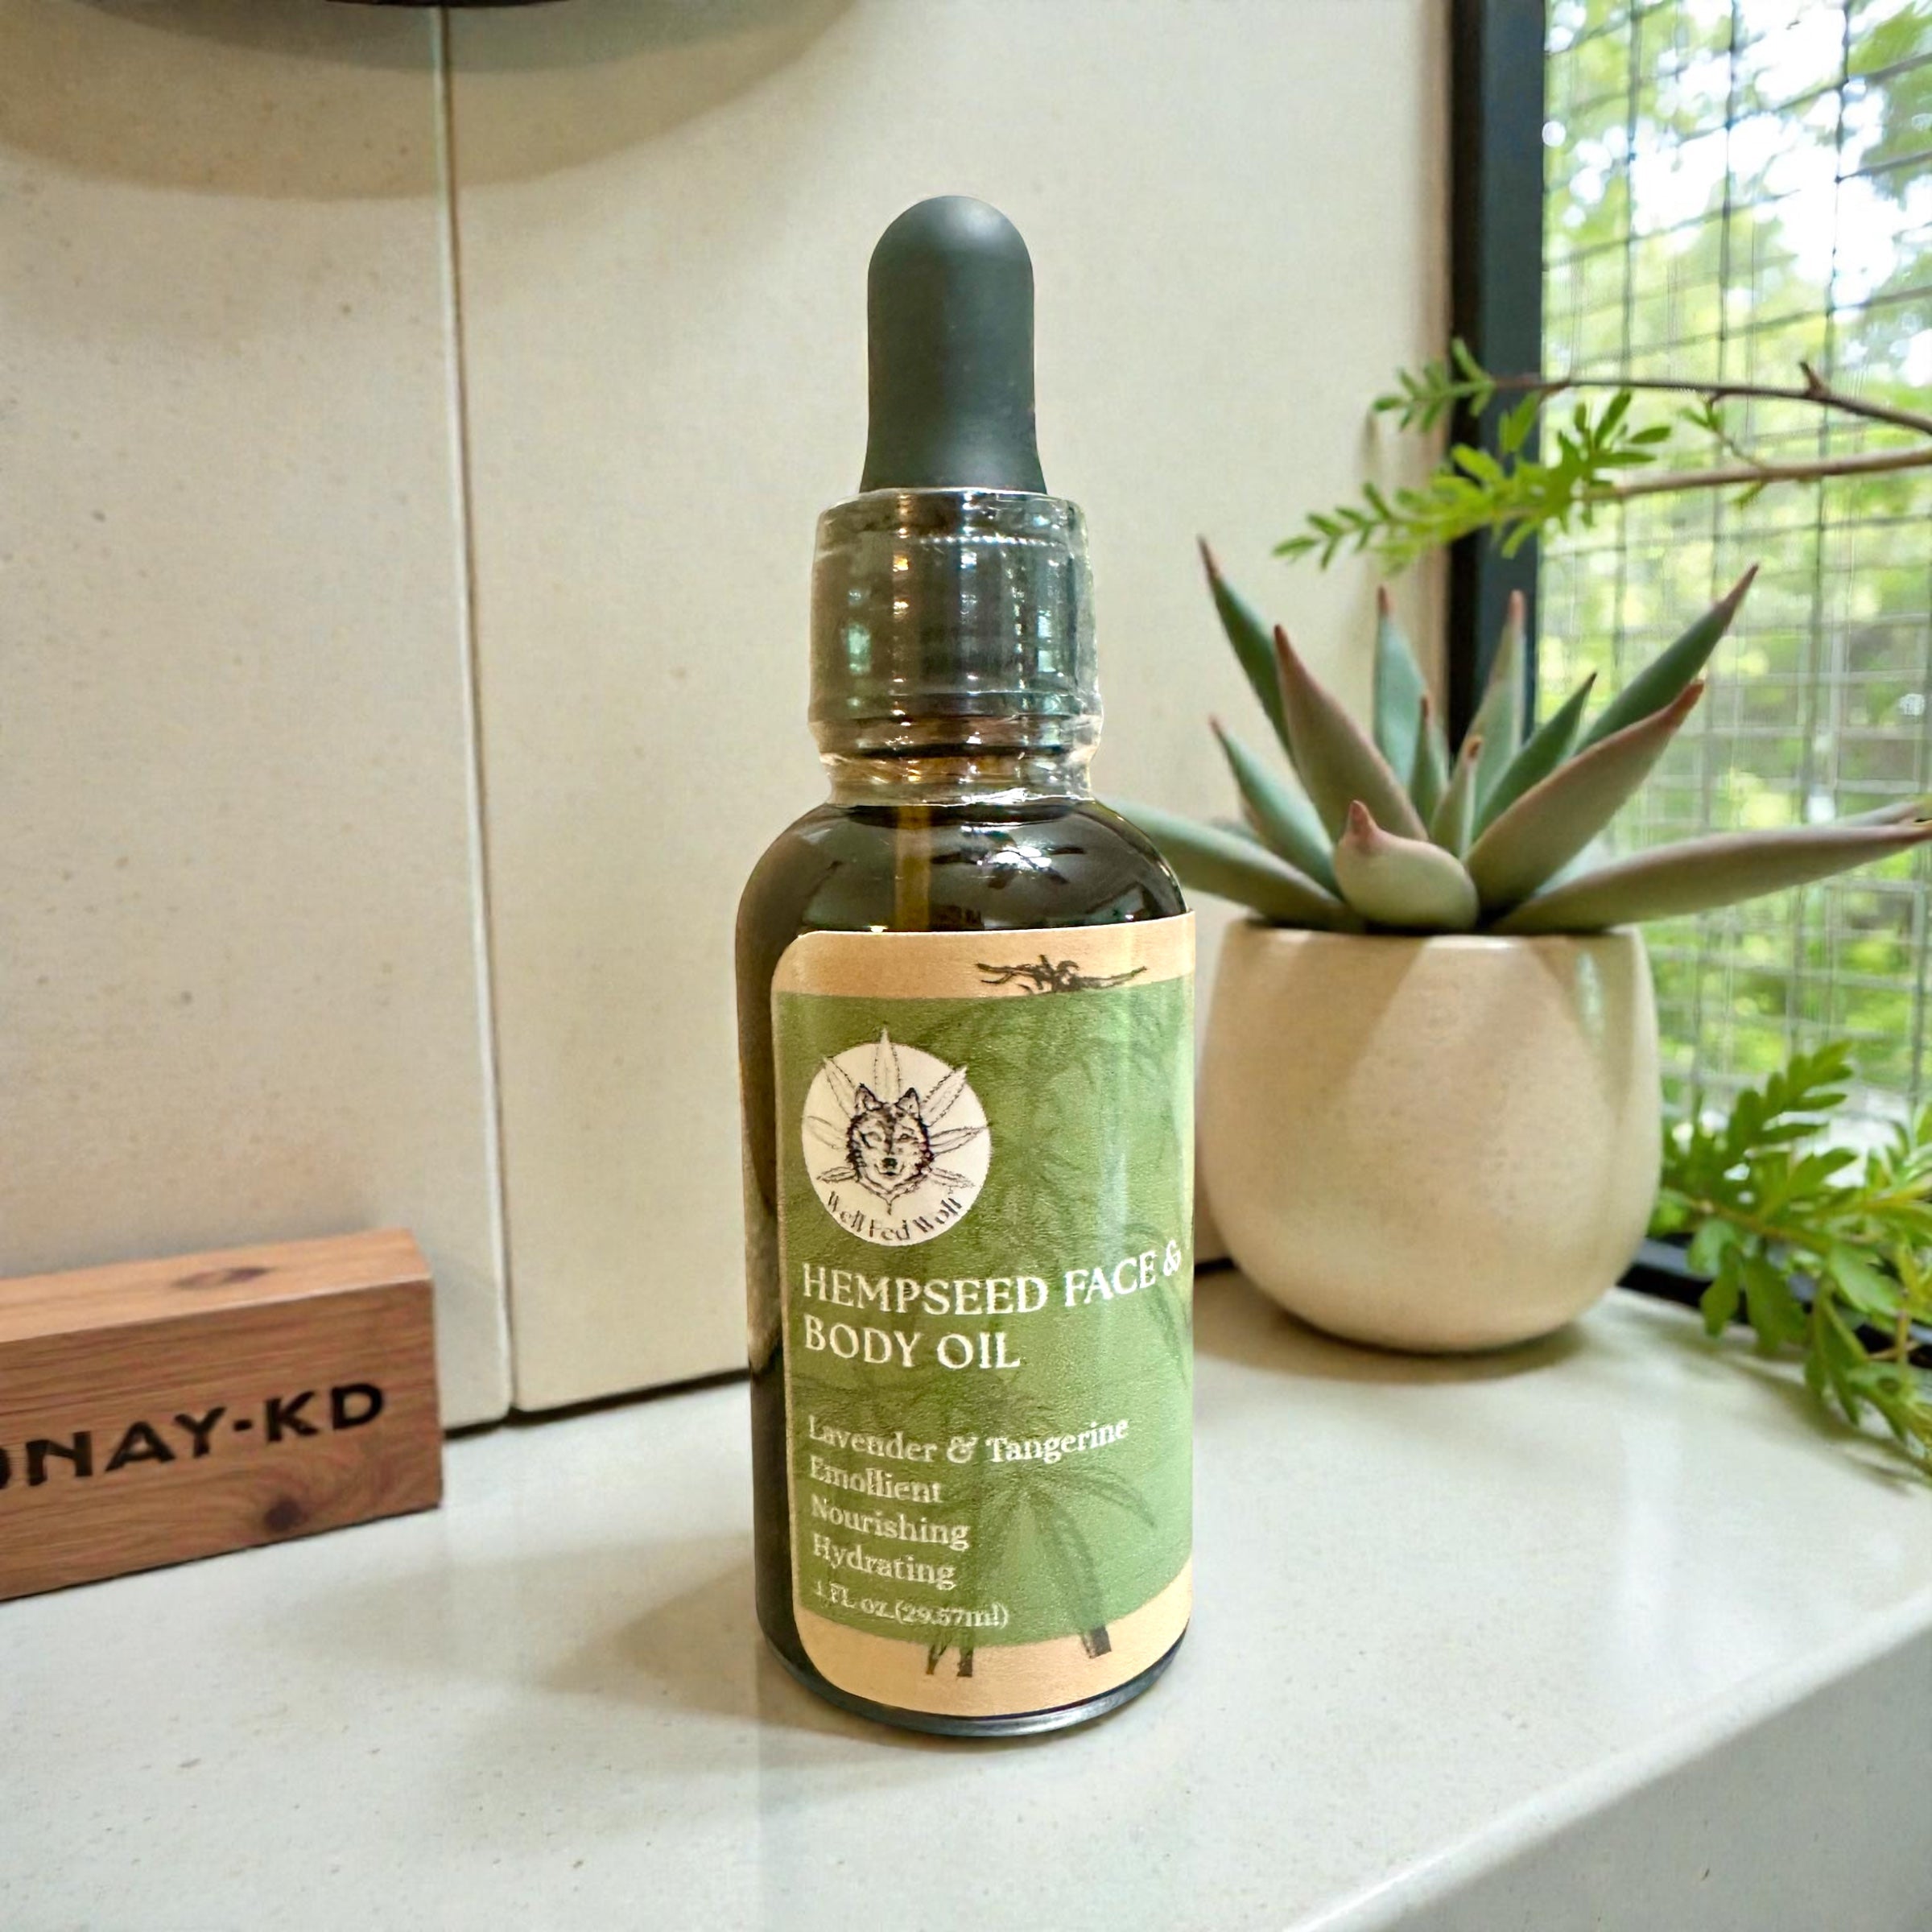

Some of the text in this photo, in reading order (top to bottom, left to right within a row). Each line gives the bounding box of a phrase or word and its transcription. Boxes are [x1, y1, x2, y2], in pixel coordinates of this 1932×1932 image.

[803, 1239, 1182, 1315] HEMPSEED FACE &
[804, 1313, 1022, 1369] BODY OIL
[0, 1382, 384, 1490] NAY-KD
[808, 1415, 1129, 1465] Lavender & Tangerine
[809, 1454, 944, 1505] Emollient
[810, 1494, 972, 1551] Nourishing
[811, 1533, 957, 1591] Hydrating
